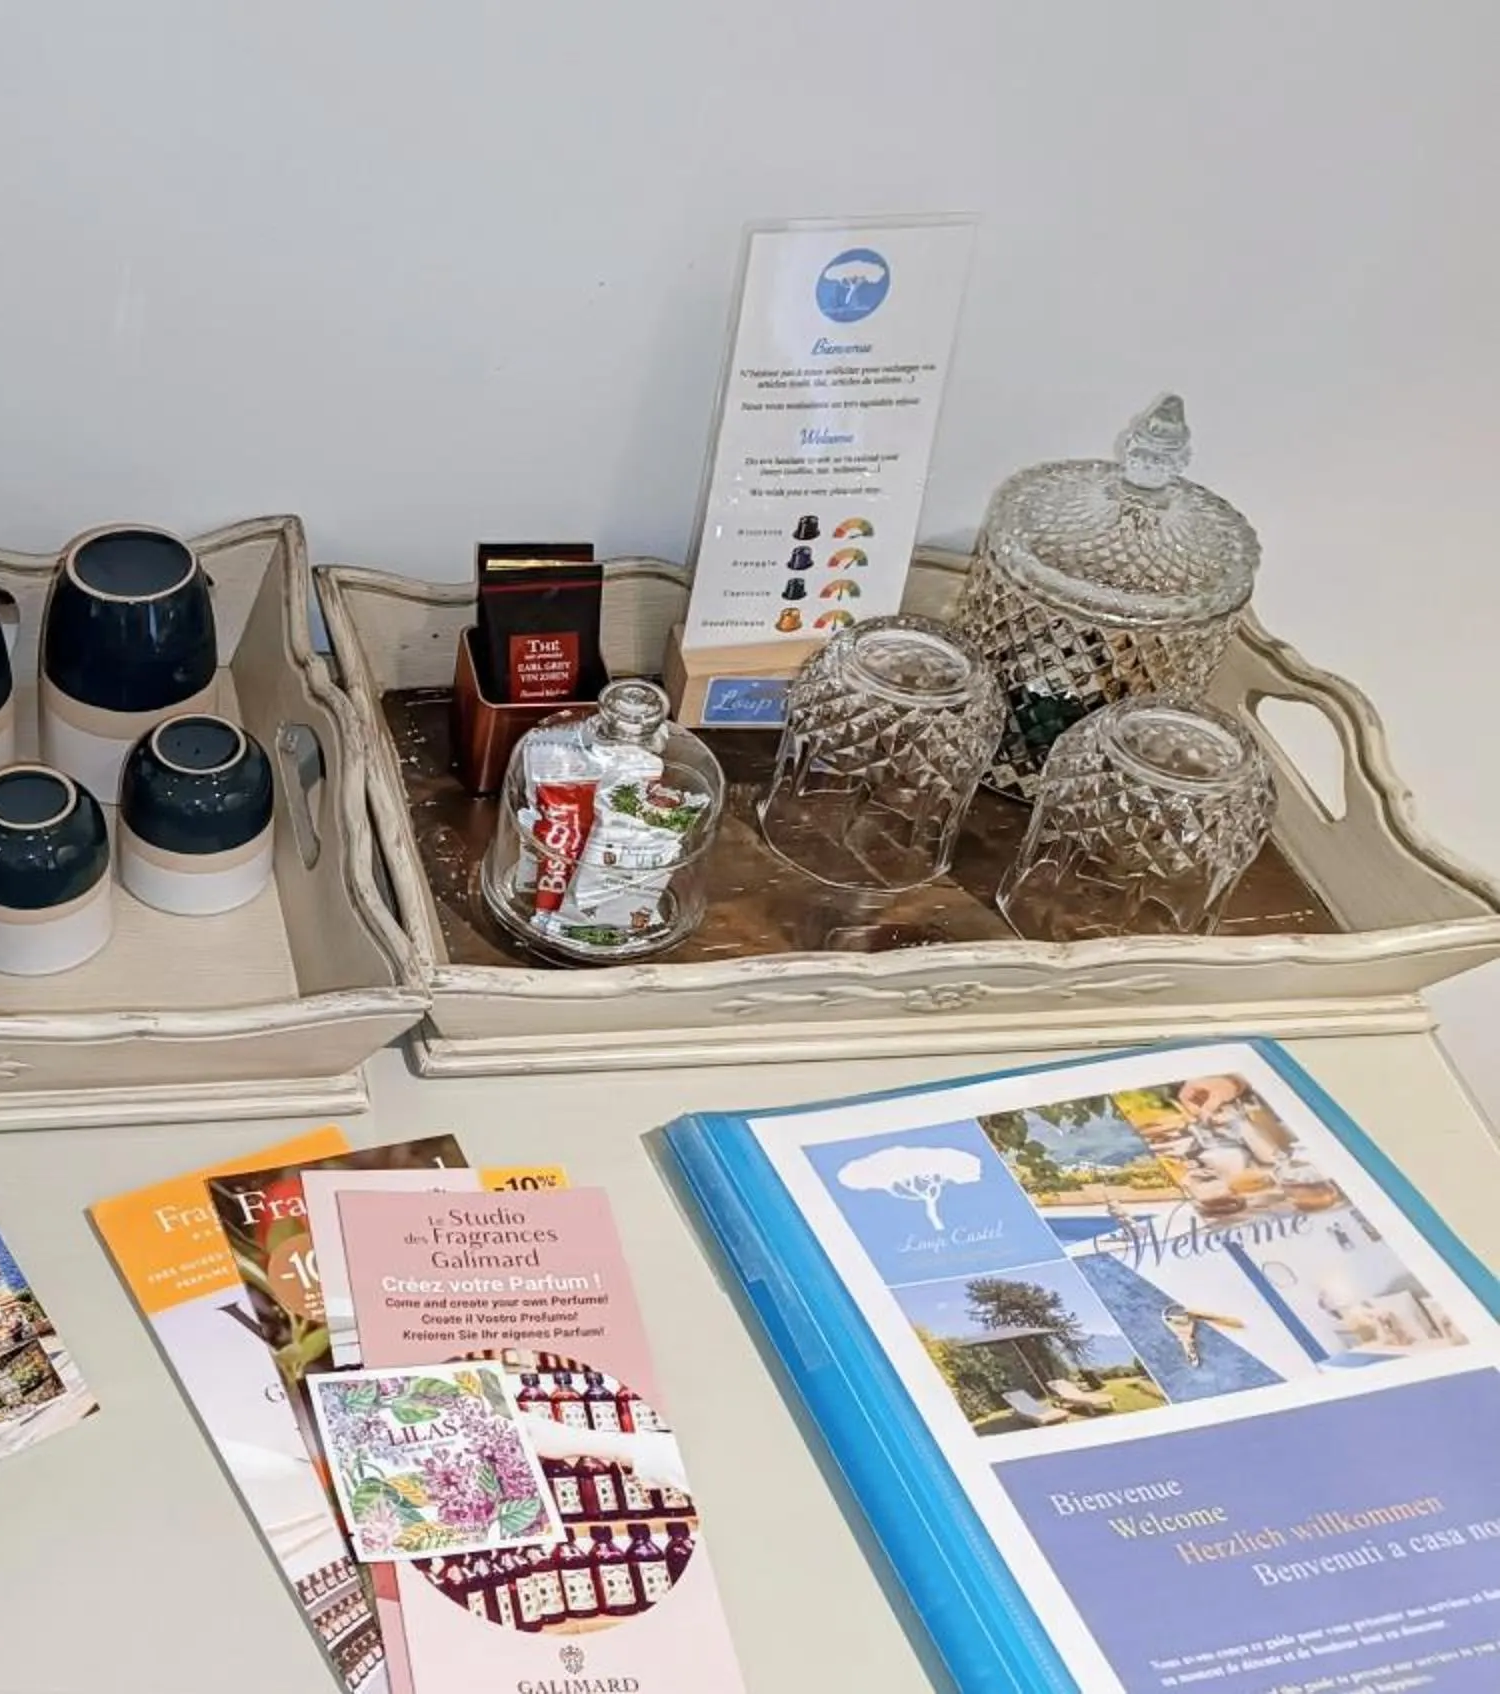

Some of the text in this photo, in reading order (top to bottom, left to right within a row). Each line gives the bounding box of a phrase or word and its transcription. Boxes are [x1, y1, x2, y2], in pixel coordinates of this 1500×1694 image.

[712, 689, 773, 712] Loup
[449, 1207, 526, 1227] Studio
[404, 1226, 560, 1249] des Fragrances
[898, 1219, 1004, 1254] Loup Castel
[1094, 1194, 1310, 1272] Welcome
[431, 1247, 541, 1270] Galimard
[381, 1275, 445, 1293] Créez
[449, 1277, 504, 1293] votre
[509, 1274, 590, 1292] Parfum
[385, 1293, 609, 1310] Come and create your own Perfume!
[421, 1313, 462, 1325] Create
[476, 1313, 518, 1324] Vostro
[458, 1329, 479, 1341] Sie
[481, 1328, 499, 1340] Ihr
[501, 1328, 550, 1342] eigenes
[387, 1419, 459, 1447] LILAS
[1050, 1479, 1184, 1517] Bienvenue
[1108, 1505, 1228, 1540] Welcome
[1176, 1495, 1446, 1566] Herzlich willkommen
[1252, 1518, 1500, 1588] Benvenuti a casa no
[517, 1678, 640, 1694] GALIMARD
